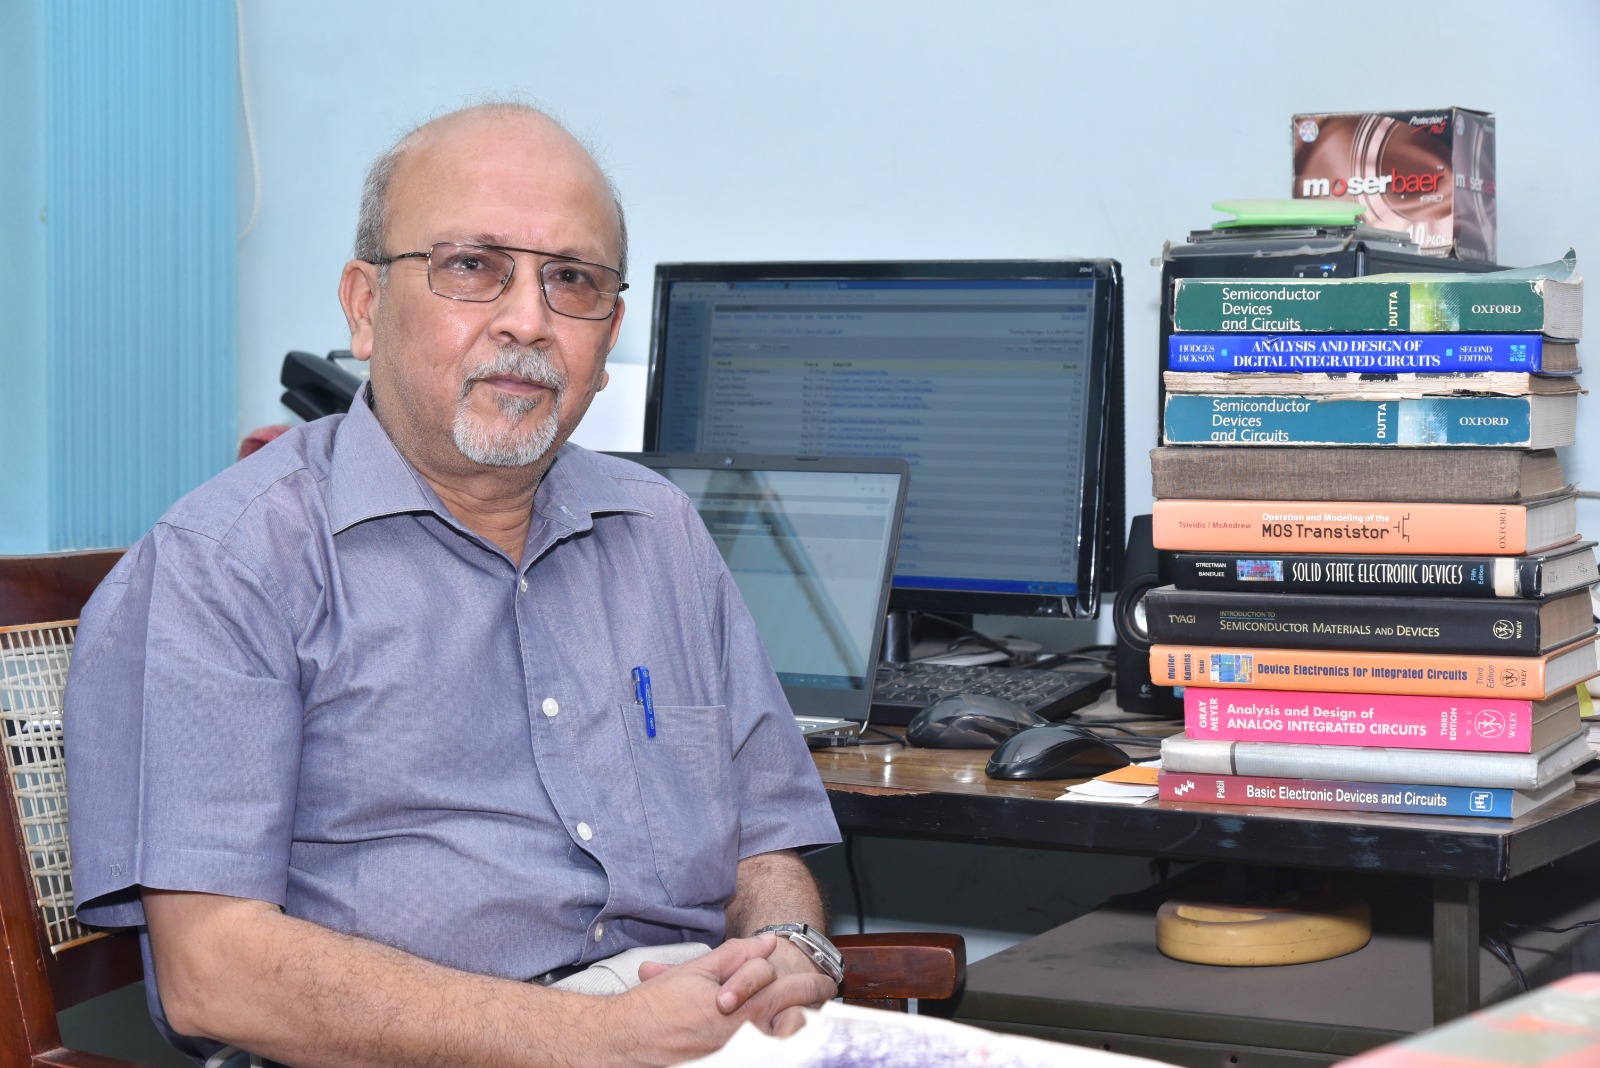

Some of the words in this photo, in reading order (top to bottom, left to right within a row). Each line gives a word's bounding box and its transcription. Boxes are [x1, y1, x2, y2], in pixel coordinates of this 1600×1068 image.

[1303, 168, 1444, 197] moserbaer
[1222, 287, 1322, 300] Semiconductor
[1222, 302, 1272, 315] Devices
[1389, 291, 1398, 326] DUTTA
[1472, 304, 1522, 314] OXFORD
[1222, 318, 1247, 330] and
[1252, 318, 1300, 330] Circuits
[1180, 344, 1214, 352] HODGES
[1252, 340, 1316, 352] ANALYSIS
[1320, 340, 1348, 352] AND
[1351, 340, 1402, 352] DESIGN
[1404, 340, 1423, 352] OF
[1178, 354, 1214, 362] JACKSON
[1234, 355, 1287, 366] DIGITAL
[1290, 355, 1374, 367] INTEGRATED
[1378, 355, 1440, 367] CIRCUITS
[1212, 400, 1310, 412] Semiconductor
[1212, 414, 1262, 426] Devices
[1377, 403, 1387, 439] DUTTA
[1460, 417, 1508, 426] OXFORD
[1212, 430, 1236, 442] and
[1241, 430, 1289, 442] Circuits
[1262, 513, 1304, 522] Operation
[1306, 514, 1322, 522] and
[1324, 514, 1363, 524] Modeling
[1365, 514, 1374, 522] of
[1376, 514, 1390, 522] the
[1262, 524, 1292, 538] MOS
[1296, 524, 1390, 539] Transistor
[1292, 562, 1322, 582] SOLID
[1326, 562, 1354, 582] STATE
[1358, 564, 1418, 584] ELECTRONIC
[1422, 564, 1463, 584] DEVICES
[1168, 614, 1196, 624] TYAGI
[1220, 620, 1308, 633] SEMICONDUCTOR
[1312, 622, 1371, 635] MATERIALS
[1374, 627, 1394, 636] AND
[1396, 625, 1440, 637] DEVICES
[1258, 664, 1290, 674] Device
[1294, 664, 1350, 676] Electronics
[1353, 666, 1368, 678] for
[1372, 667, 1424, 680] Integrated
[1427, 669, 1468, 680] Circuits
[1198, 700, 1207, 728] GRAY
[1210, 698, 1218, 732] MEYER
[1227, 704, 1280, 718] Analysis
[1284, 706, 1308, 717] and
[1314, 706, 1356, 720] Design
[1360, 708, 1374, 719] of
[1227, 718, 1284, 731] ANALOG
[1288, 720, 1365, 734] INTEGRATED
[1370, 723, 1426, 736] CIRCUITS
[1450, 708, 1458, 740] EDITION
[1508, 712, 1518, 738] WILEY
[1174, 780, 1195, 796] EEE
[1216, 780, 1226, 798] Patil
[1246, 785, 1276, 799] Basic
[1279, 786, 1333, 802] Electronic
[1336, 789, 1378, 804] Devices
[1382, 792, 1402, 804] and
[1404, 792, 1447, 806] Circuits
